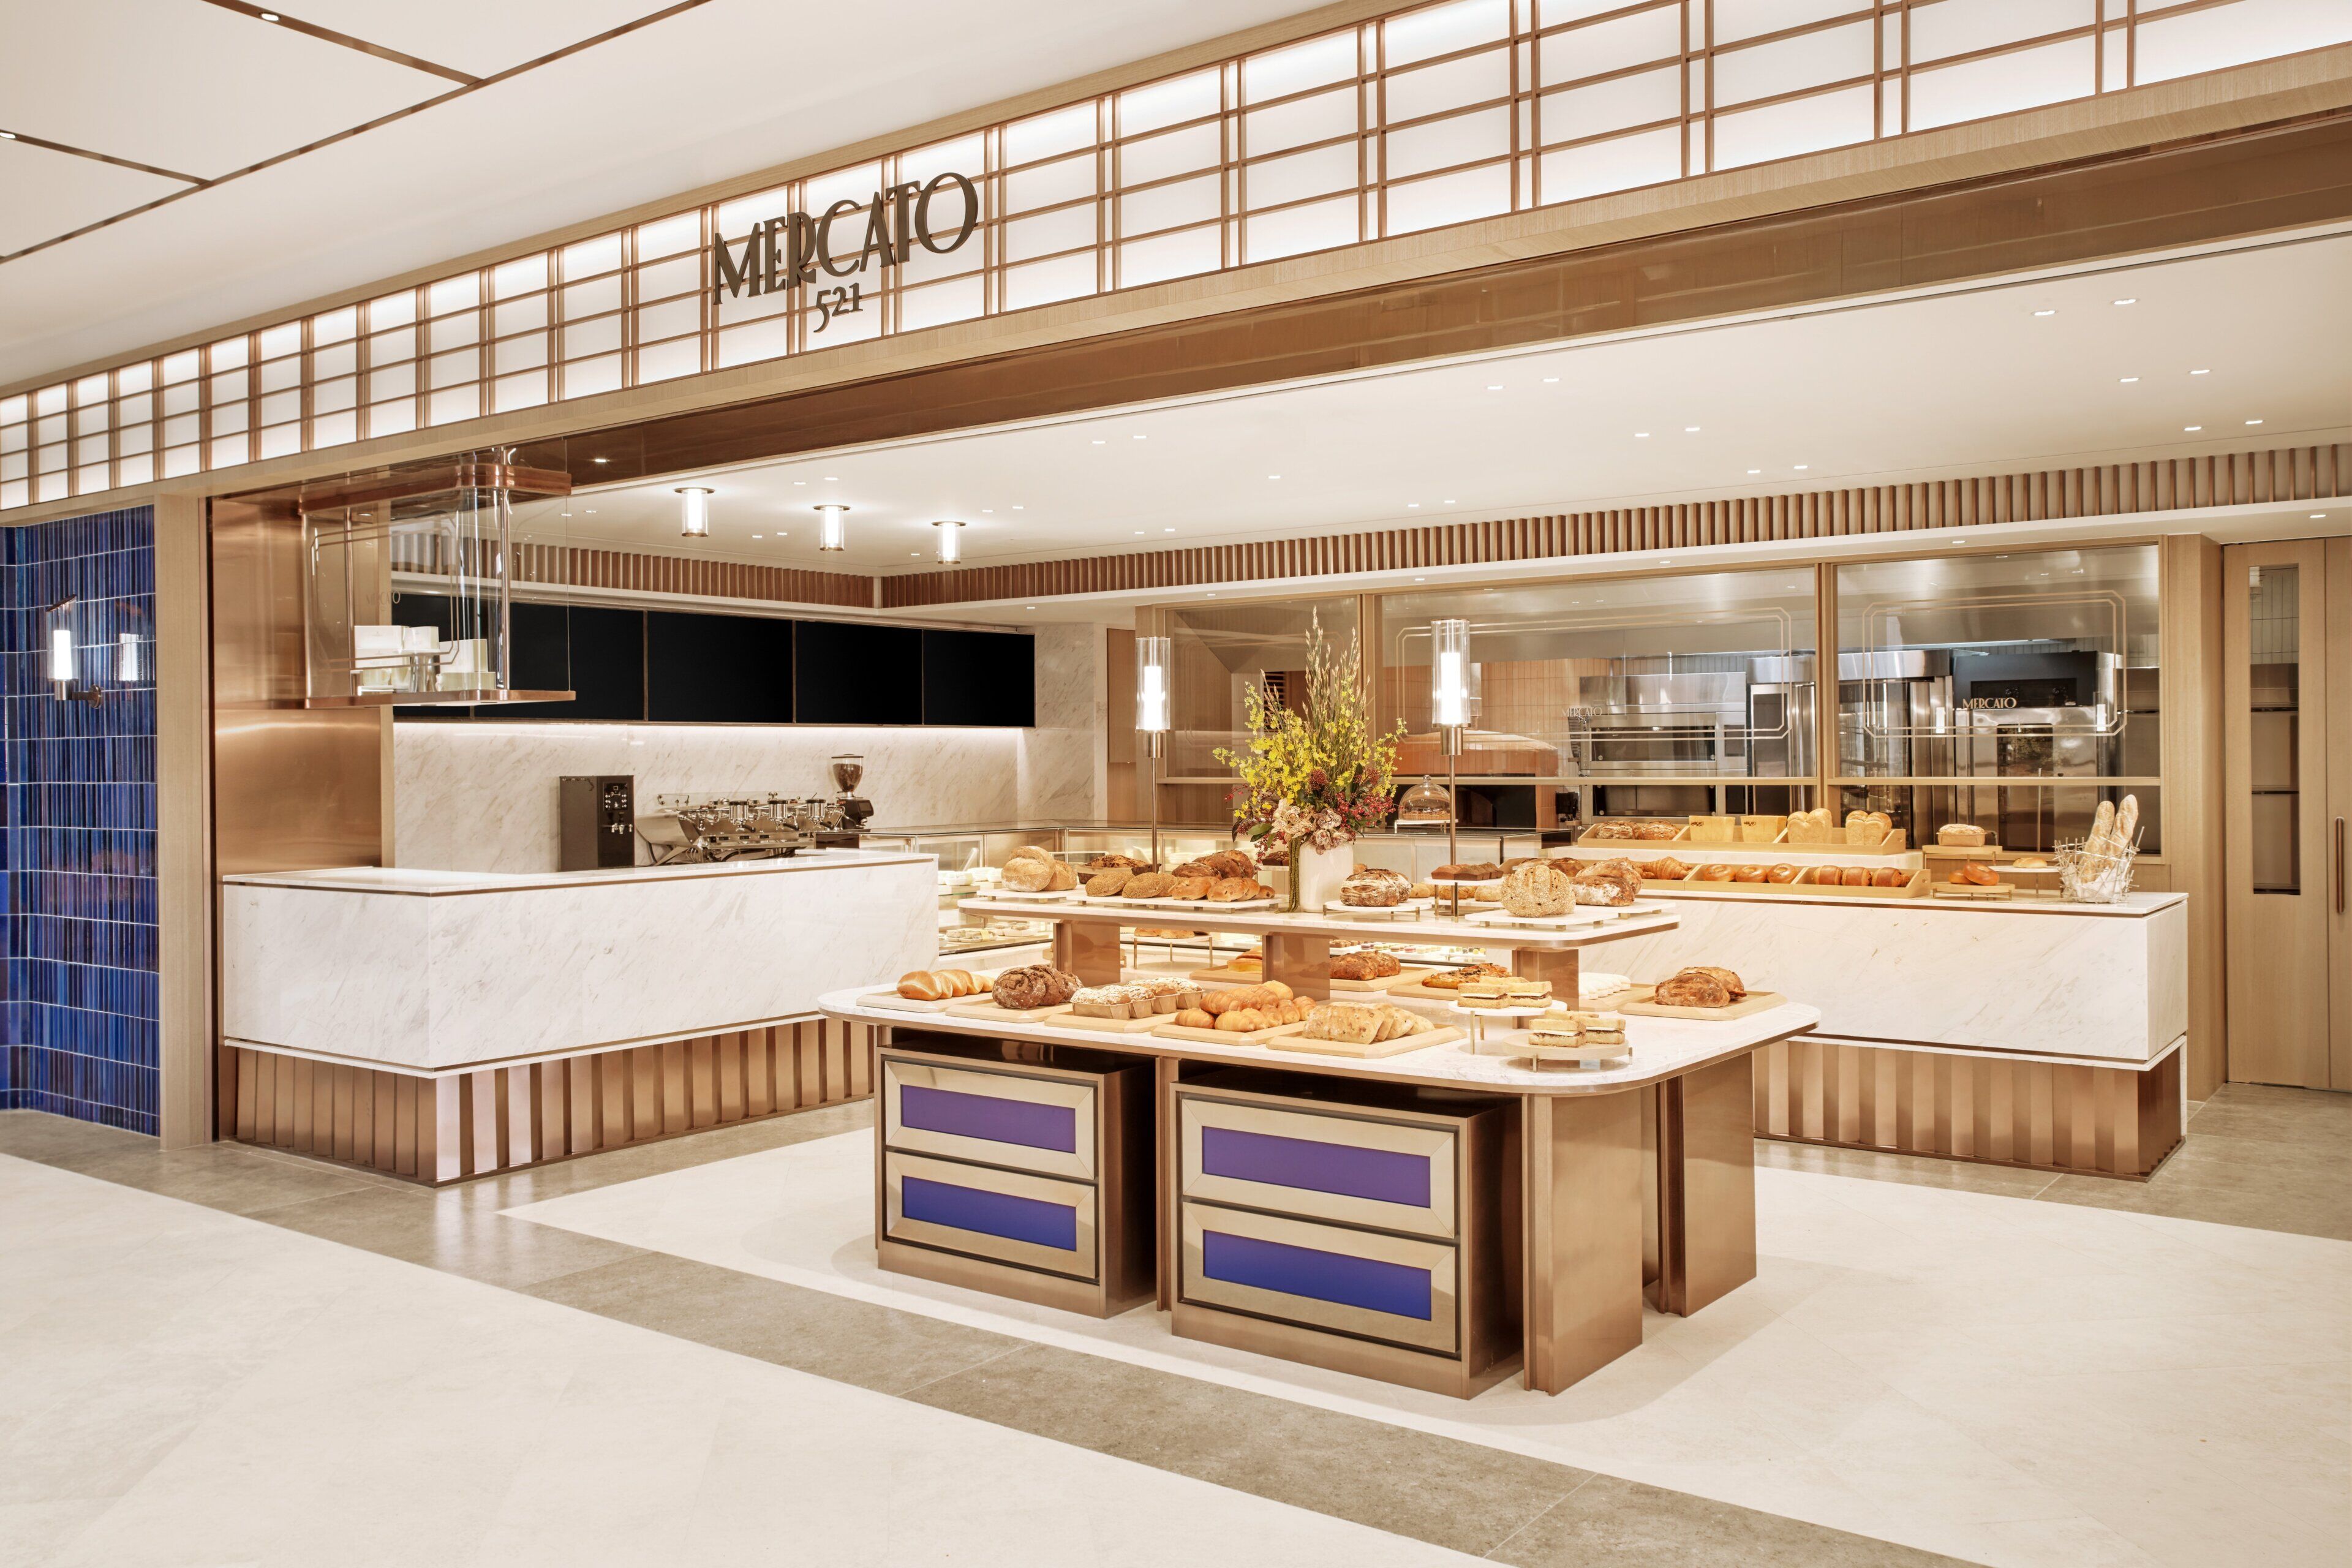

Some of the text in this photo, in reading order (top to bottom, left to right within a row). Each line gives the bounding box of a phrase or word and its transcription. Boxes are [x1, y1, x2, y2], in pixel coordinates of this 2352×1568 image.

[713, 172, 978, 304] MERCATO
[813, 282, 864, 333] 521
[1562, 706, 1602, 717] MERCATO
[1962, 697, 2017, 709] MERCATO
